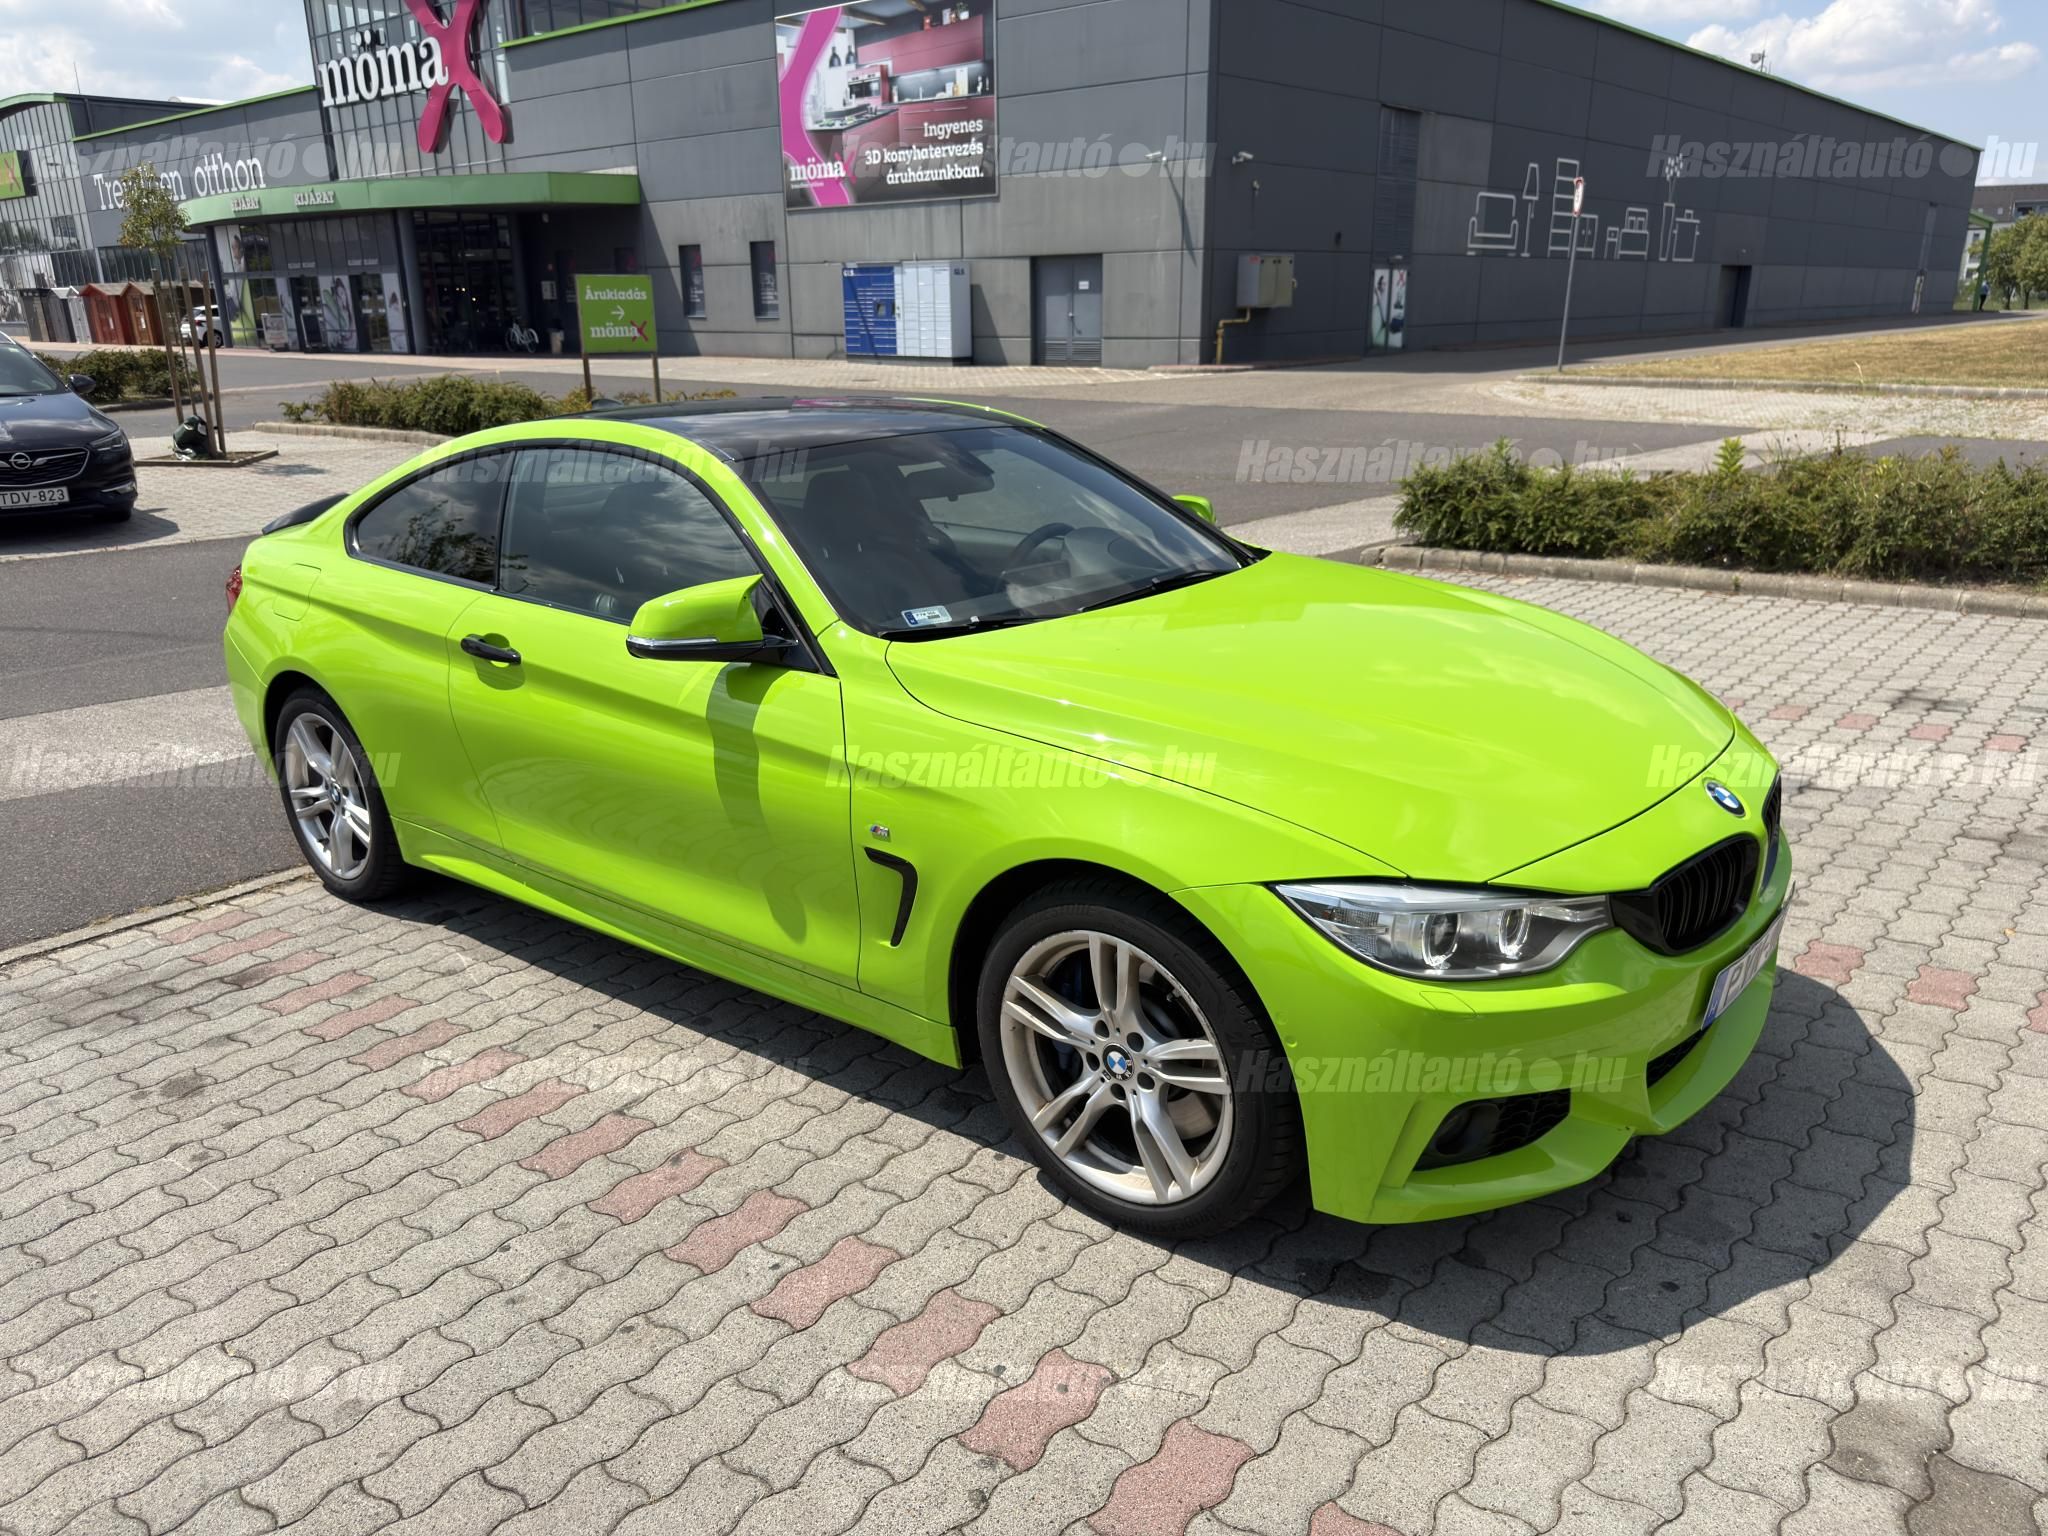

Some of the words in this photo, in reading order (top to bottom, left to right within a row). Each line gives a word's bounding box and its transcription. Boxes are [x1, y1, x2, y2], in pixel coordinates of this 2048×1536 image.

[923, 119, 983, 140] Ingyenes
[865, 150, 881, 166] 3D
[884, 137, 984, 167] konyhatervezés
[194, 152, 266, 196] otthon
[886, 164, 984, 184] áruházunkban.
[294, 187, 335, 206] KIJÁRAT
[585, 285, 647, 300] Árukiadás
[0, 488, 65, 505] TDV-823
